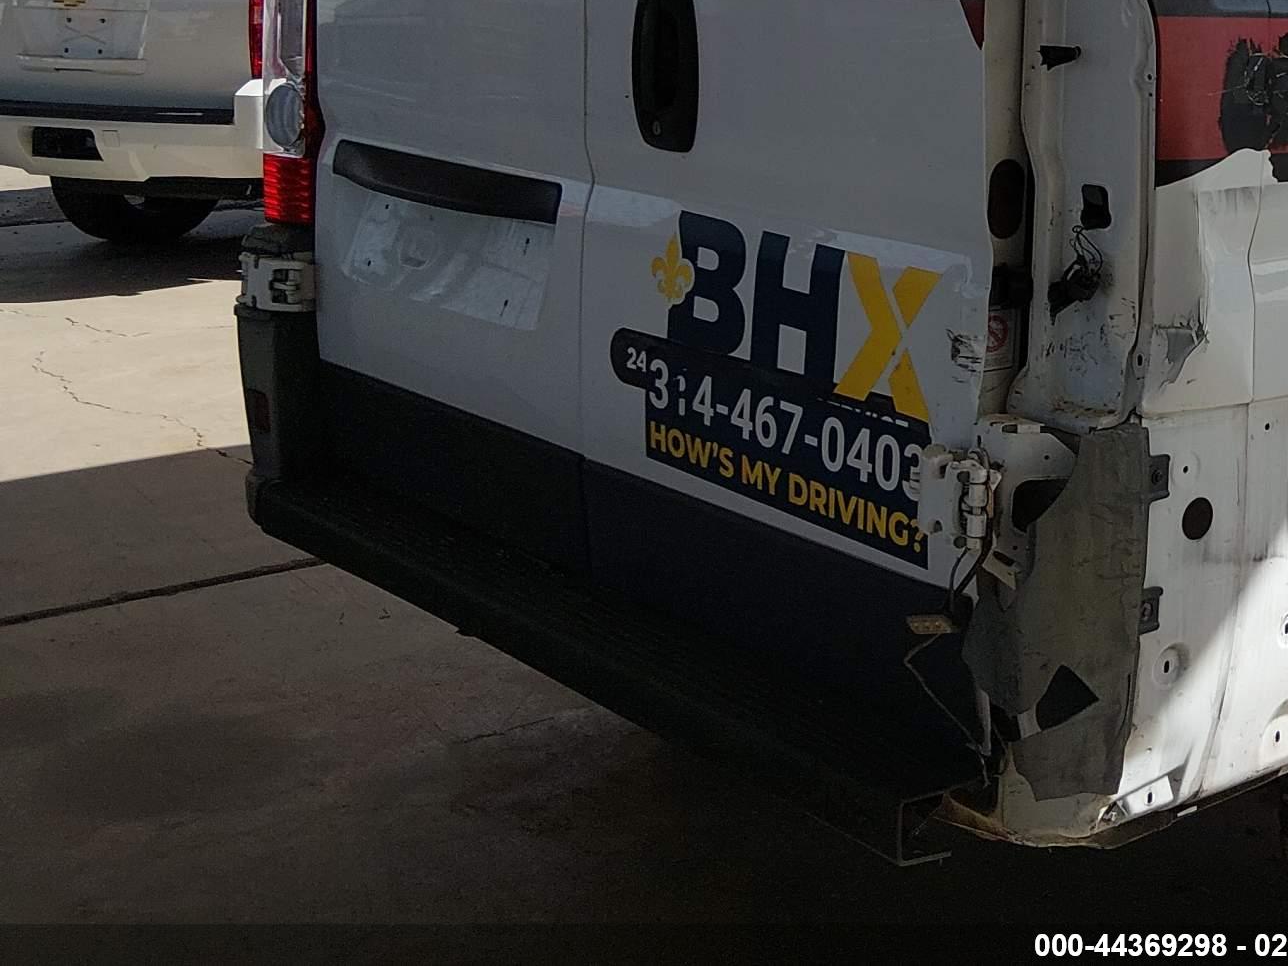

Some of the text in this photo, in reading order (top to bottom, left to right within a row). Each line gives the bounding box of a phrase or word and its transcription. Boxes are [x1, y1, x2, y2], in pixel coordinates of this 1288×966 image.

[666, 209, 944, 424] BHX
[649, 359, 922, 502] 314-467-0403
[650, 421, 929, 553] HOW'S MY DRIVING?
